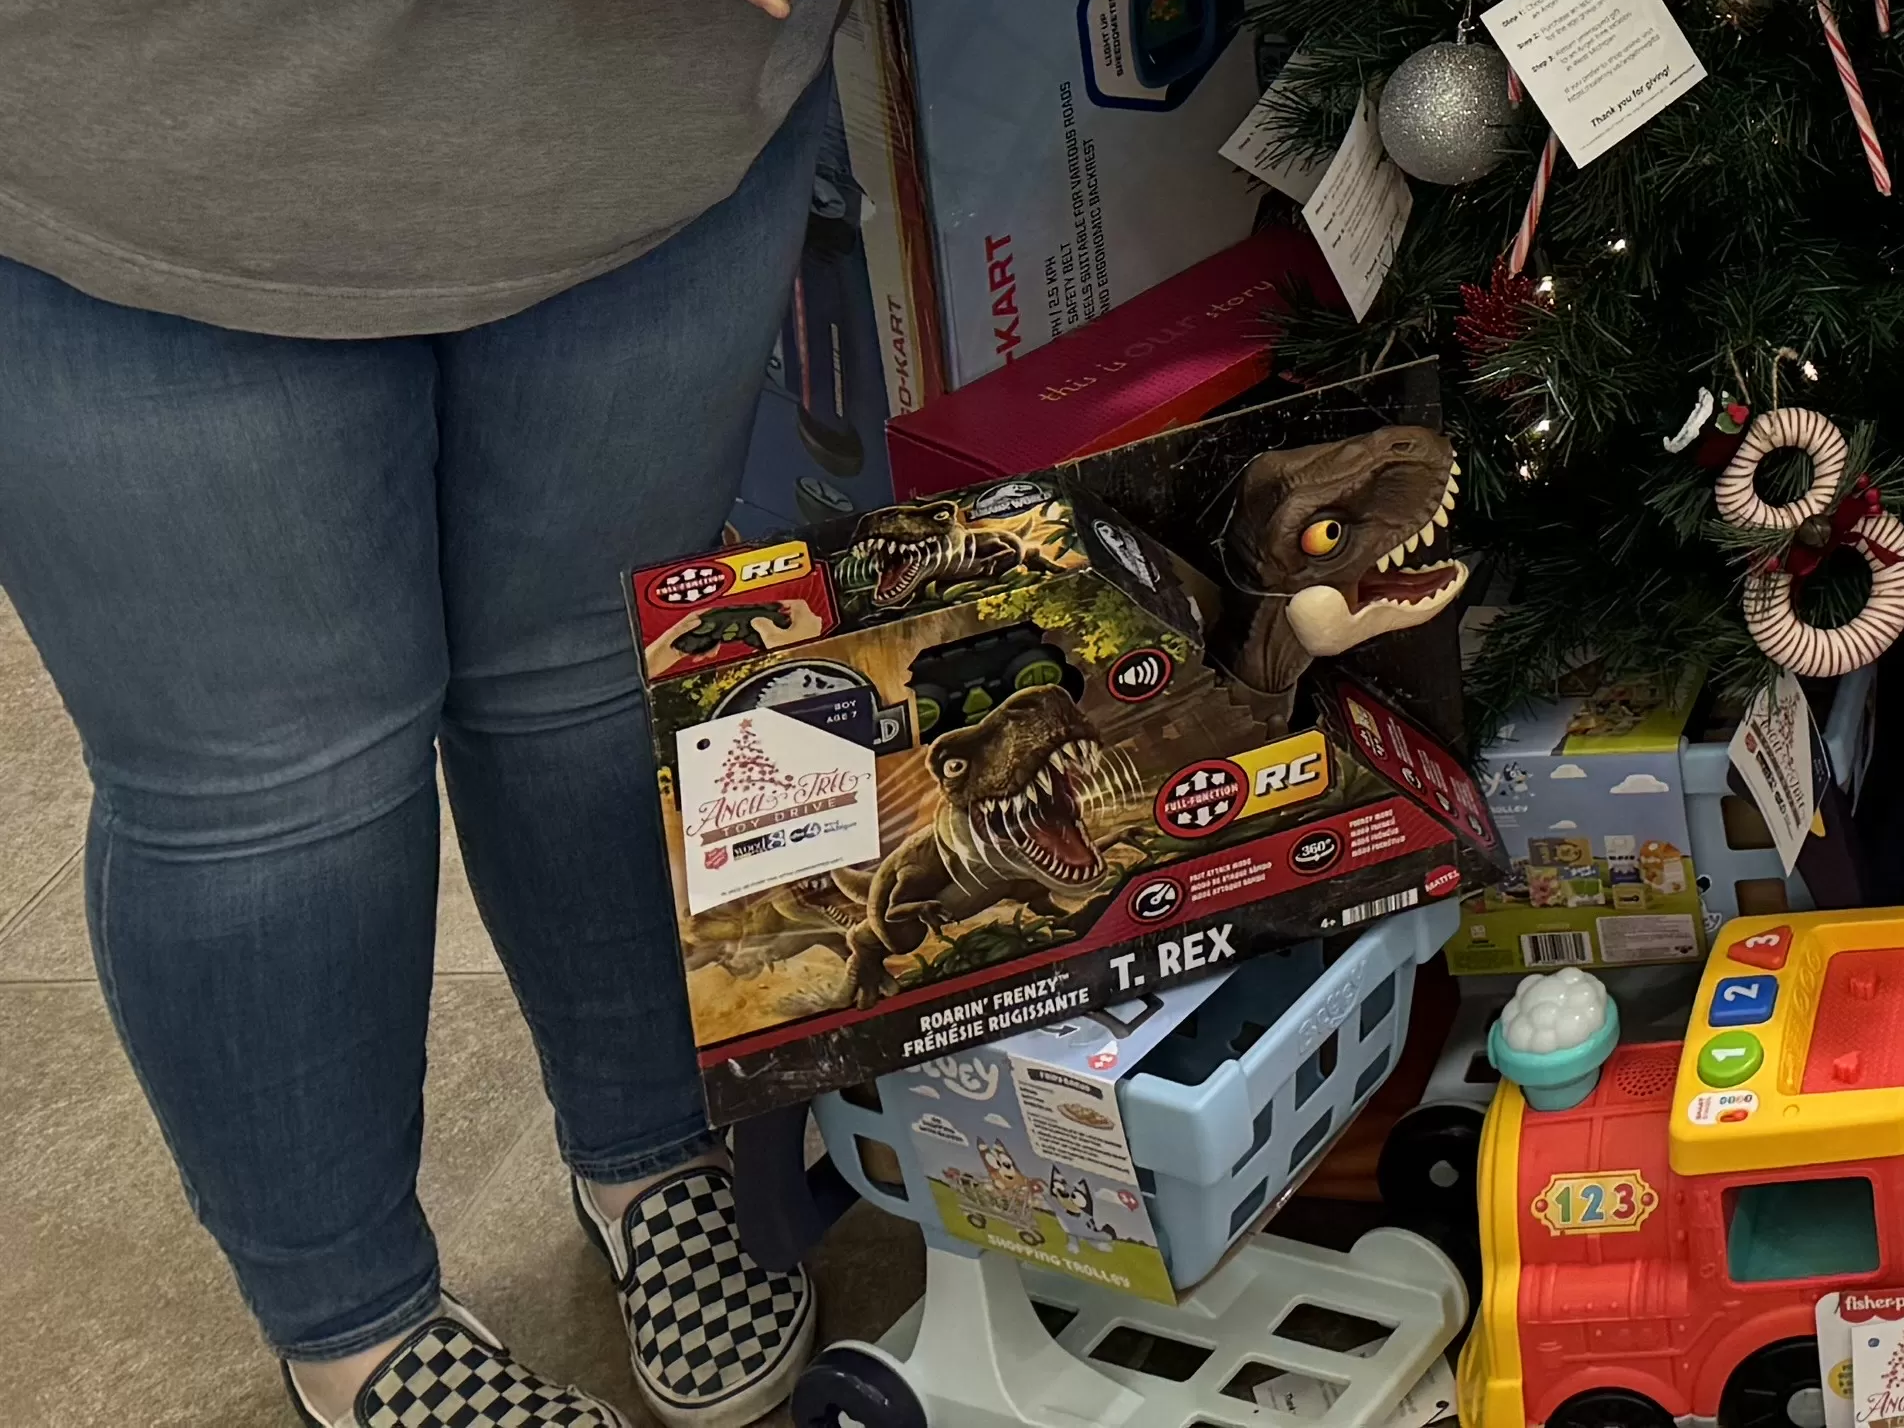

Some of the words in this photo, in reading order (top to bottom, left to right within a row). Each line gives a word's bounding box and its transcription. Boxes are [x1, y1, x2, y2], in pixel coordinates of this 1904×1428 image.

[741, 552, 804, 582] RC
[833, 699, 857, 711] BOY
[825, 713, 847, 725] AGE
[1254, 752, 1320, 795] RC
[722, 818, 760, 838] TOY
[774, 797, 838, 824] DRIVE
[1424, 868, 1461, 892] MATTEL
[1320, 917, 1337, 929] 4+
[1745, 934, 1780, 948] 3
[1110, 955, 1145, 992] T.
[1157, 923, 1237, 978] REX
[1723, 982, 1759, 1002] 2
[902, 1014, 986, 1059] FRÉNÉSIE
[988, 987, 1090, 1033] RUGISSANTE
[919, 997, 990, 1034] ROARIN'
[1711, 1047, 1746, 1063] 1
